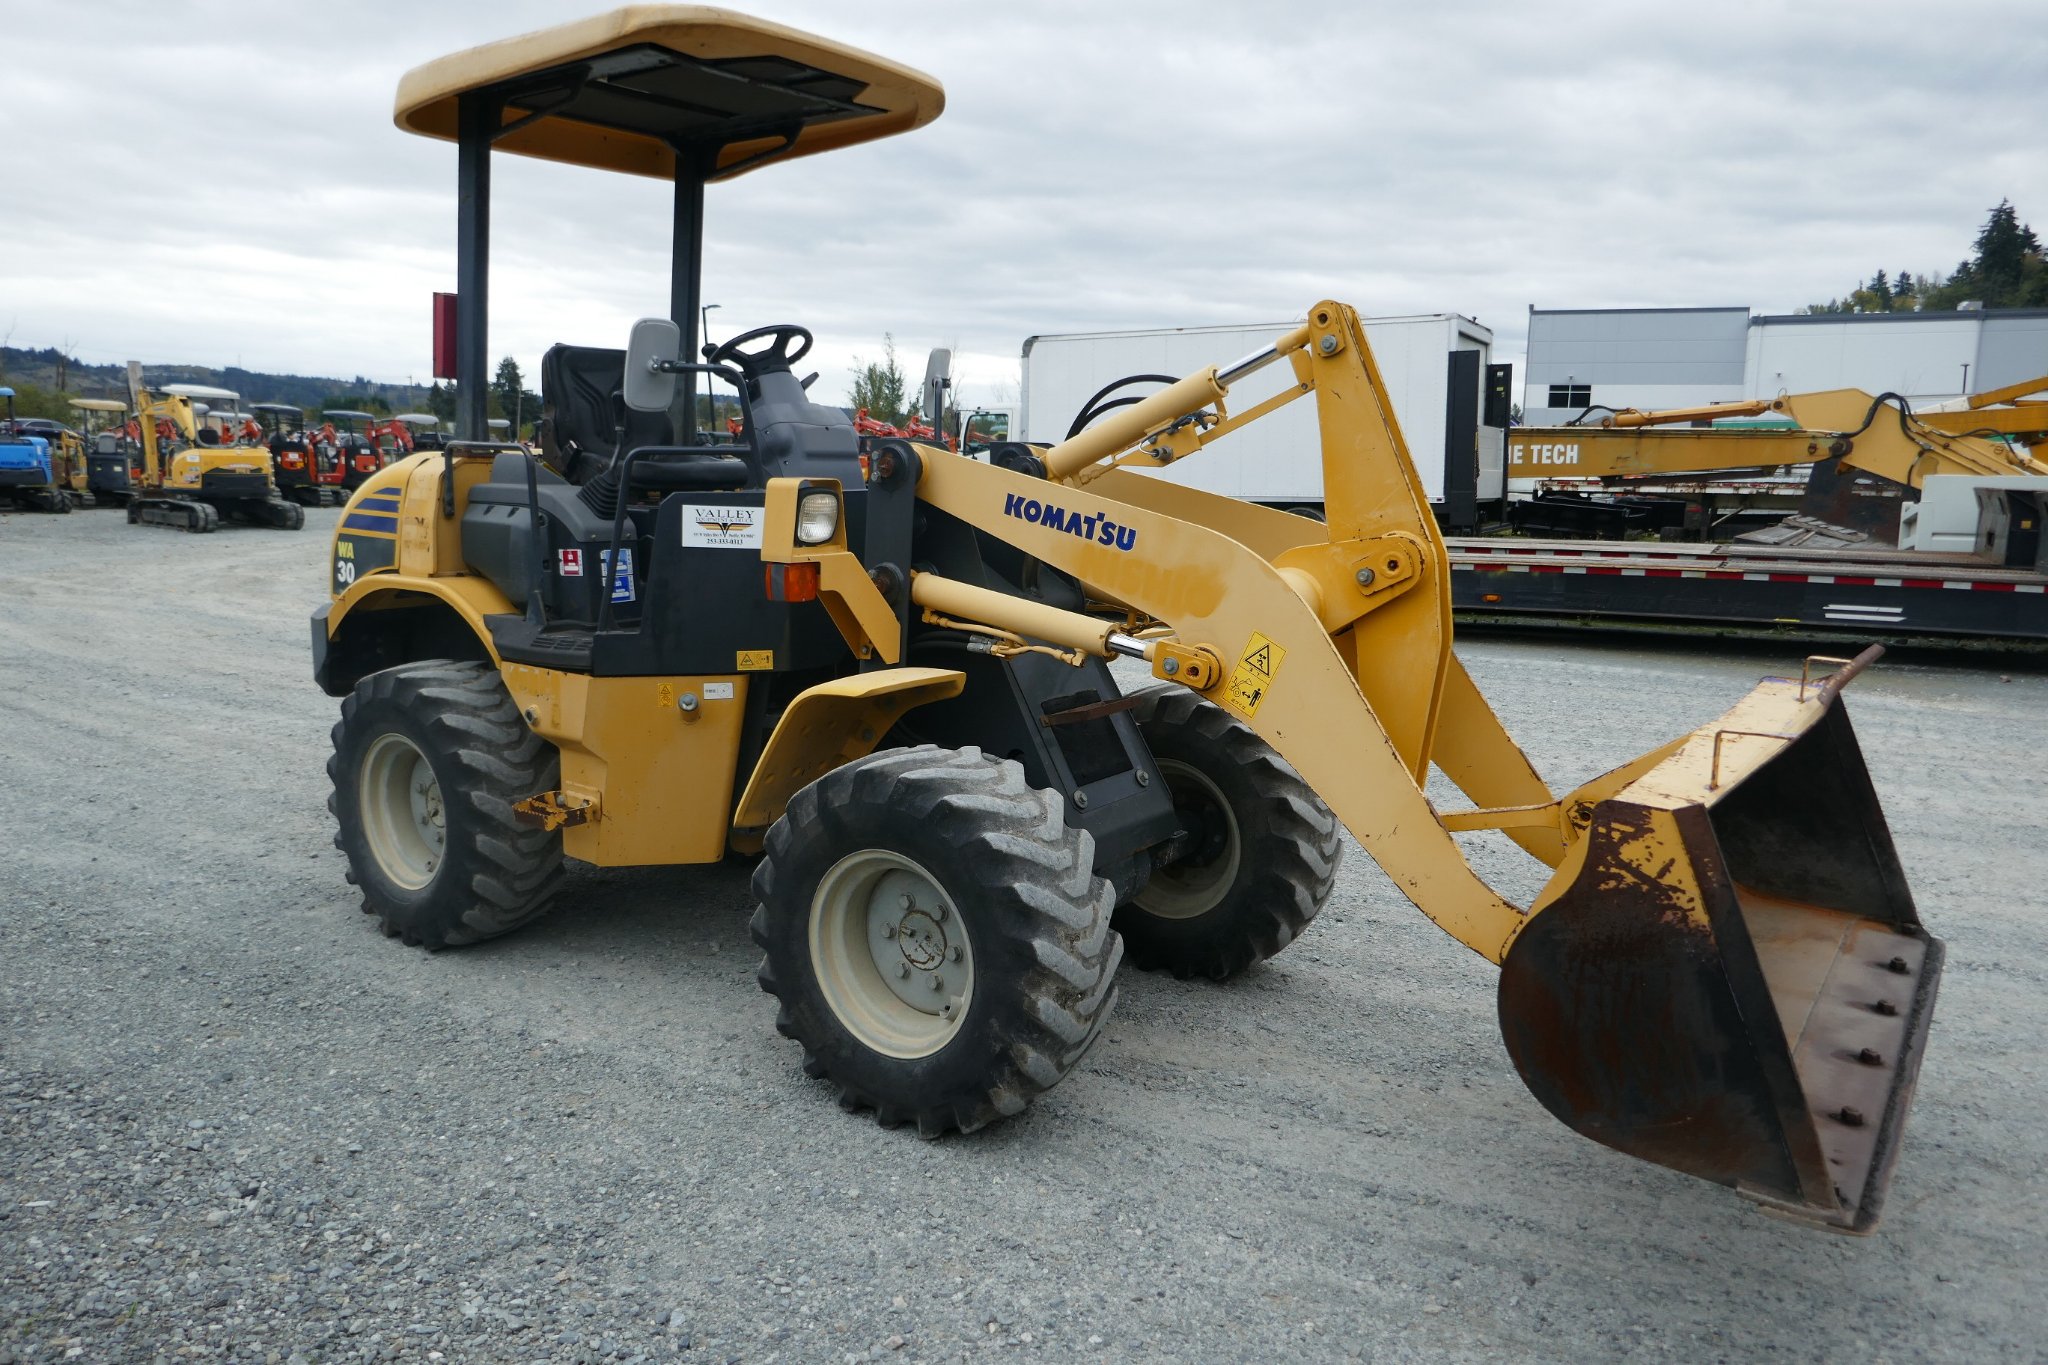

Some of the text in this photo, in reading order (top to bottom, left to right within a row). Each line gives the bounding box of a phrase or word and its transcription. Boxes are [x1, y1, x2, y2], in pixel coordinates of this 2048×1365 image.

[1530, 444, 1579, 465] TECH
[695, 509, 754, 518] VALLEY
[1003, 492, 1137, 551] KOMATSU
[337, 541, 355, 559] WA
[337, 560, 355, 584] 30
